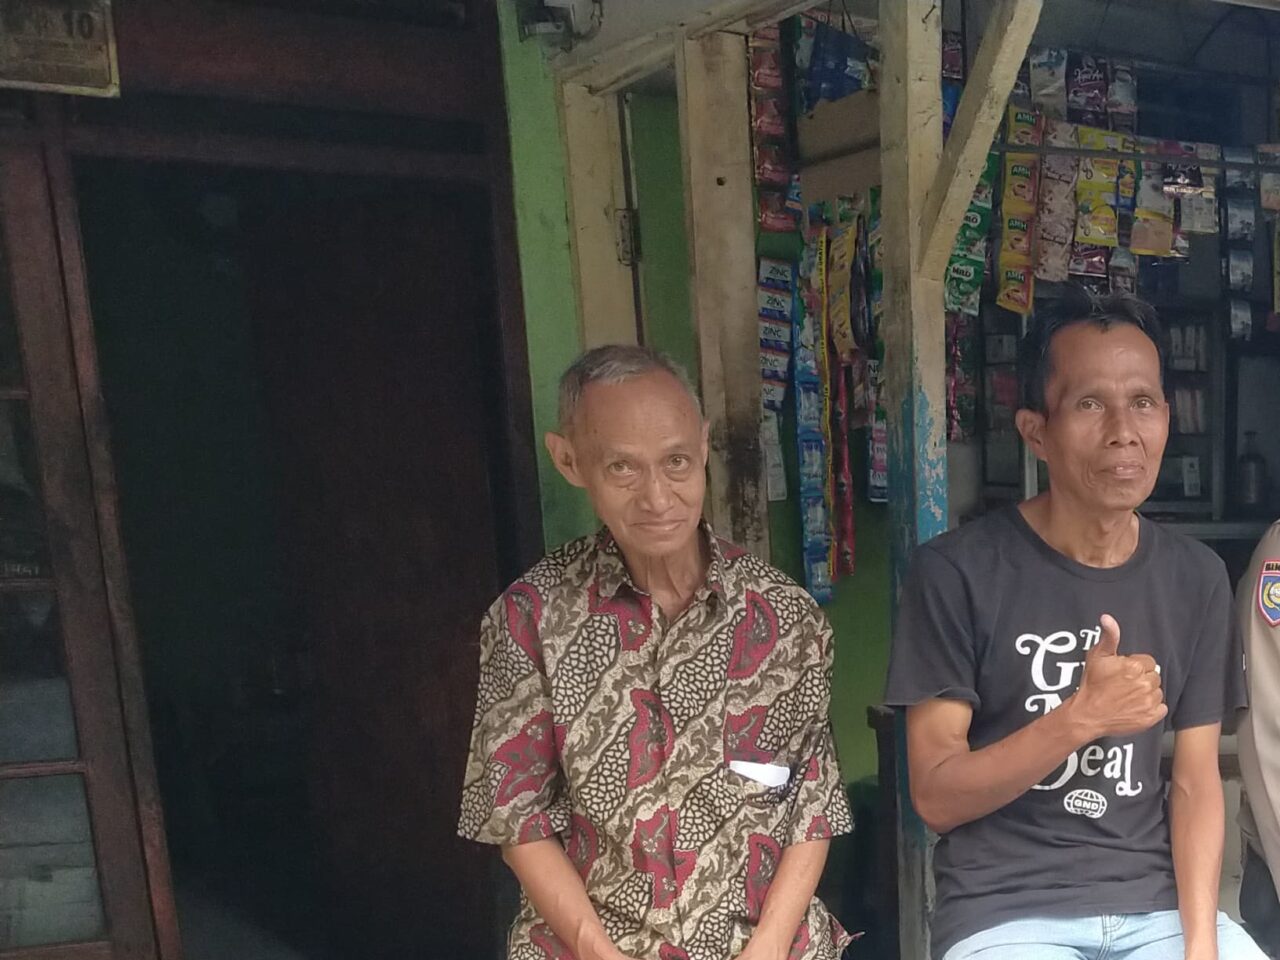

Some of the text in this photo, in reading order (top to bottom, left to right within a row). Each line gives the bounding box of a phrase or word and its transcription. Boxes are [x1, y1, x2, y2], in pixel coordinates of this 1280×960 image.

[769, 265, 789, 278] ZINC
[766, 296, 785, 309] ZINC
[763, 326, 782, 338] ZINC
[1074, 799, 1099, 811] GND
